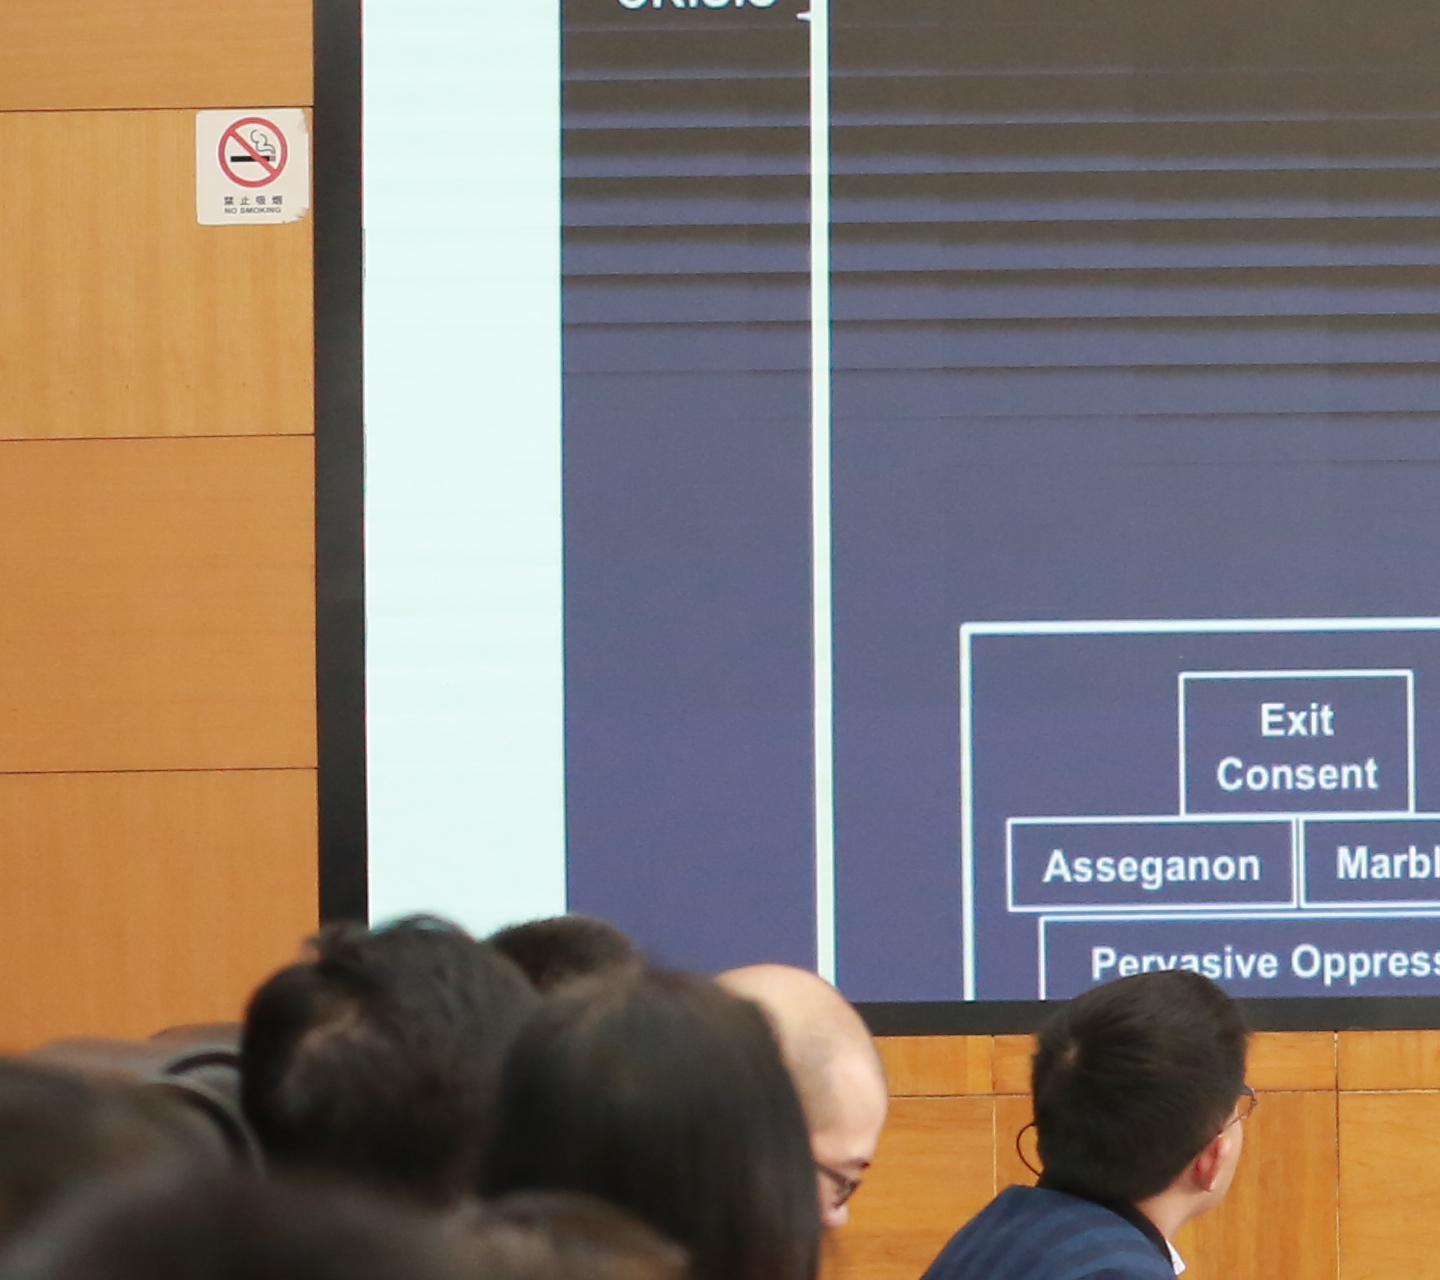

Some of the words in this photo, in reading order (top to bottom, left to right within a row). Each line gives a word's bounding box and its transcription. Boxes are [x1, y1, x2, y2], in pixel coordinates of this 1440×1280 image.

[1262, 703, 1335, 737] Exit
[1218, 757, 1379, 792] Consent
[1043, 850, 1261, 891] Asseganon
[1091, 945, 1278, 980] Pervasive
